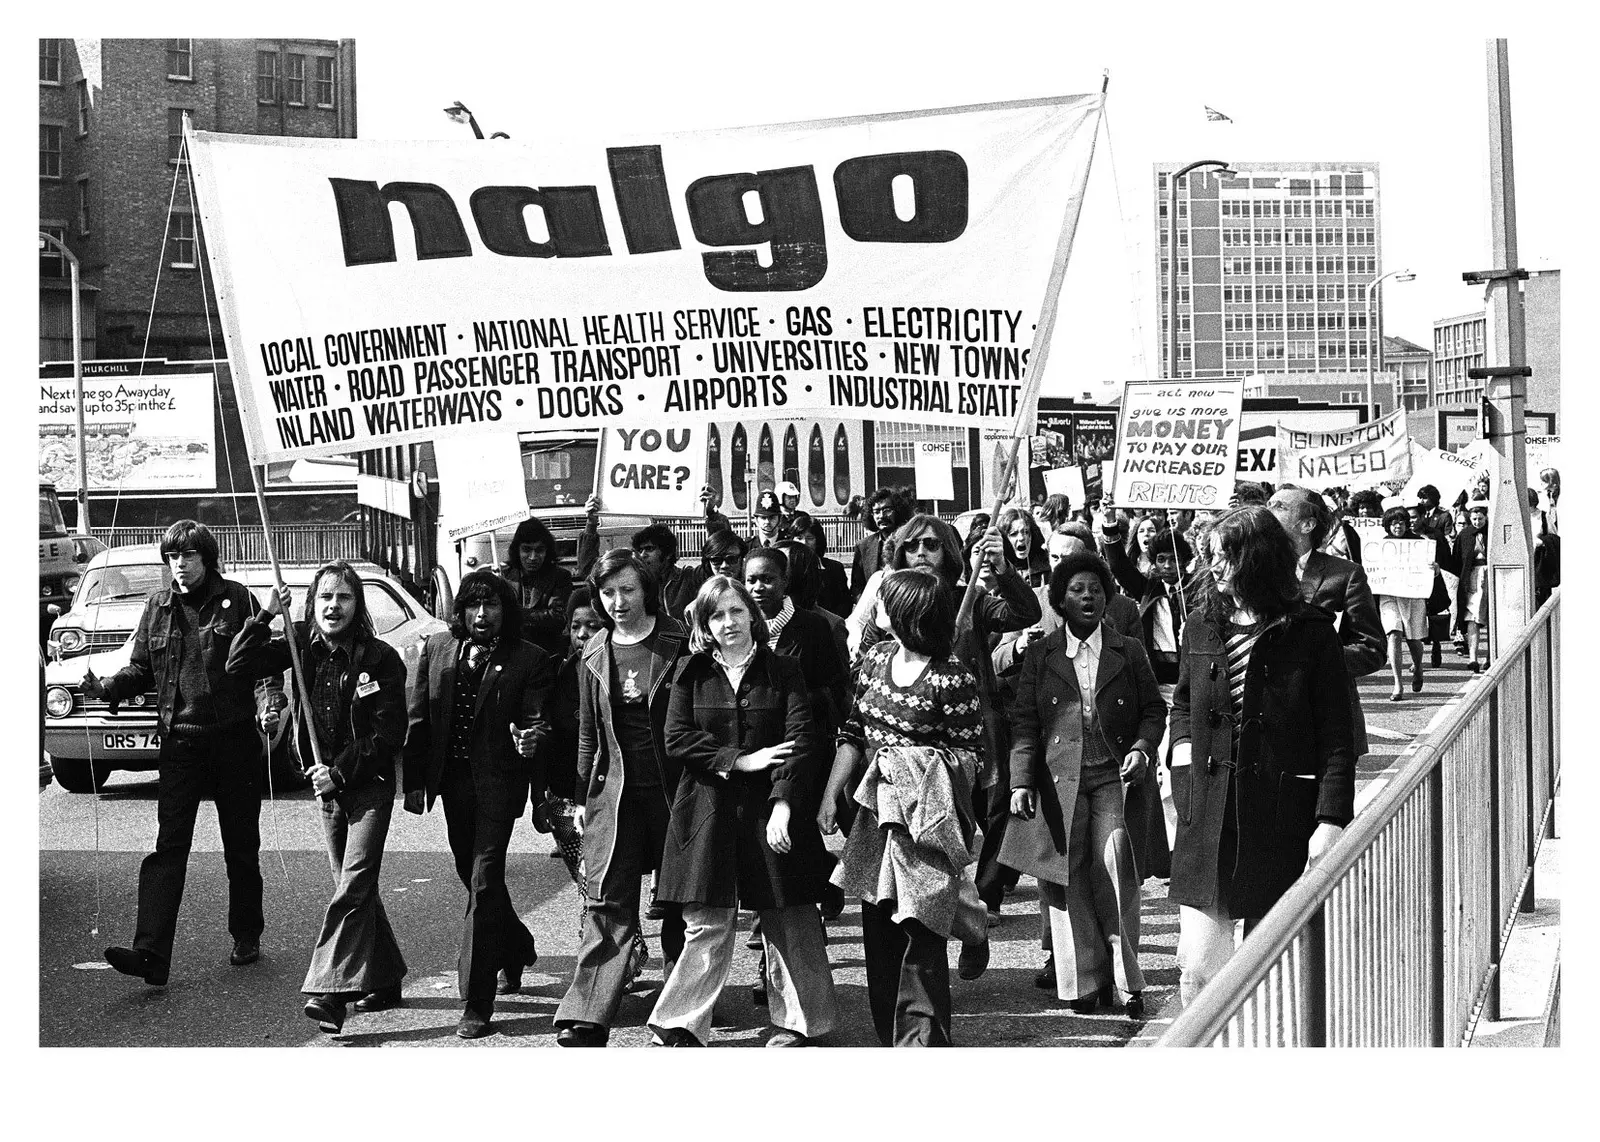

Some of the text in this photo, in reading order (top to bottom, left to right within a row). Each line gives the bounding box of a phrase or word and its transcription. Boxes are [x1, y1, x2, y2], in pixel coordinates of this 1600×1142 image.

[329, 144, 968, 291] nalgo
[260, 307, 1023, 376] LOCAL GOVERNMENT NATIONAL HEALTH SERVICE GAS ELECTRICITY
[82, 364, 129, 374] HURCHILL
[268, 375, 327, 413] WATER
[347, 365, 405, 402] ROAD
[414, 353, 540, 394] PASSENGER
[551, 344, 681, 383] TRANSPORT
[713, 340, 869, 374] UNIVERSITIES
[894, 342, 940, 376] NEW
[41, 384, 170, 402] Next tme go Awayday
[1157, 388, 1215, 398] act now
[39, 398, 177, 415] and sav up to 35p in the £
[276, 408, 355, 449] INLAND
[363, 390, 502, 436] WATERWAYS
[538, 384, 624, 420] DOCKS
[664, 375, 788, 413] AIRPORTS
[829, 375, 954, 414] INDUSTRIAL
[1130, 406, 1228, 419] give us more
[1126, 418, 1234, 440] MONEY
[1290, 421, 1395, 449] ISLINGTON
[617, 428, 691, 452] YOU
[922, 443, 950, 452] COHSE
[1525, 436, 1547, 445] OHSE
[1127, 442, 1228, 457] TO PAY OUR
[1123, 459, 1226, 476] INCREASED
[1299, 450, 1386, 478] NALGO
[1440, 452, 1478, 469] COHSE
[610, 463, 691, 491] CARE?
[1128, 481, 1218, 505] RENTS
[105, 734, 135, 748] ORS
